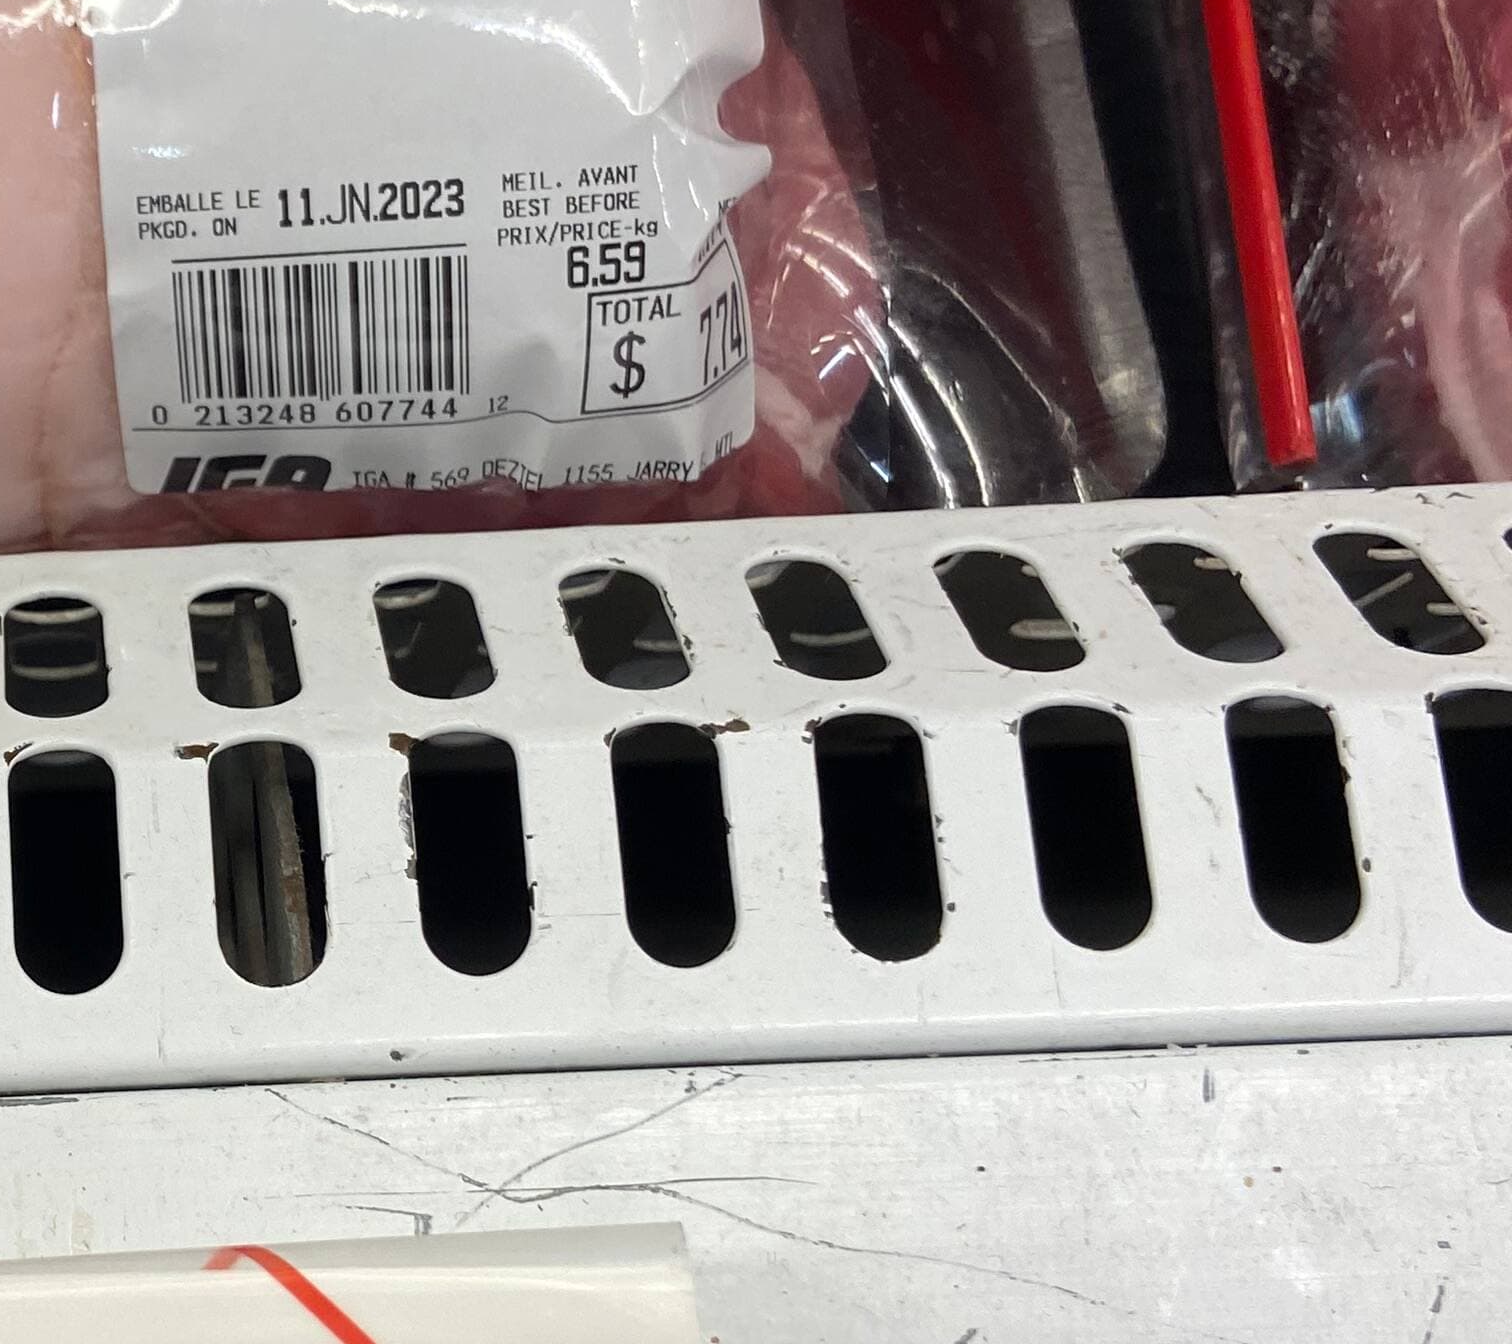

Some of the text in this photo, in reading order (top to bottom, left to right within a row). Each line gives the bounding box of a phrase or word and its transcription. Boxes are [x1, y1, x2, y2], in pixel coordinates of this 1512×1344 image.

[502, 164, 639, 193] MEIL. AVANT
[137, 189, 261, 215] EMBALLE LE
[277, 178, 465, 228] 11.JN.2023
[502, 191, 640, 218] BEST BEFORE
[138, 216, 238, 240] PKGD. ON
[497, 218, 659, 248] PRIX/PRICE-kg
[567, 240, 646, 289] 6.59
[595, 293, 682, 327] TOTAL
[609, 280, 745, 398] $ 7.74
[152, 397, 459, 427] 0 213248 607744
[488, 395, 509, 412] 12
[352, 470, 390, 489] IGA
[430, 466, 471, 490] 569
[564, 463, 614, 485] 1155
[626, 460, 695, 484] JARRY
